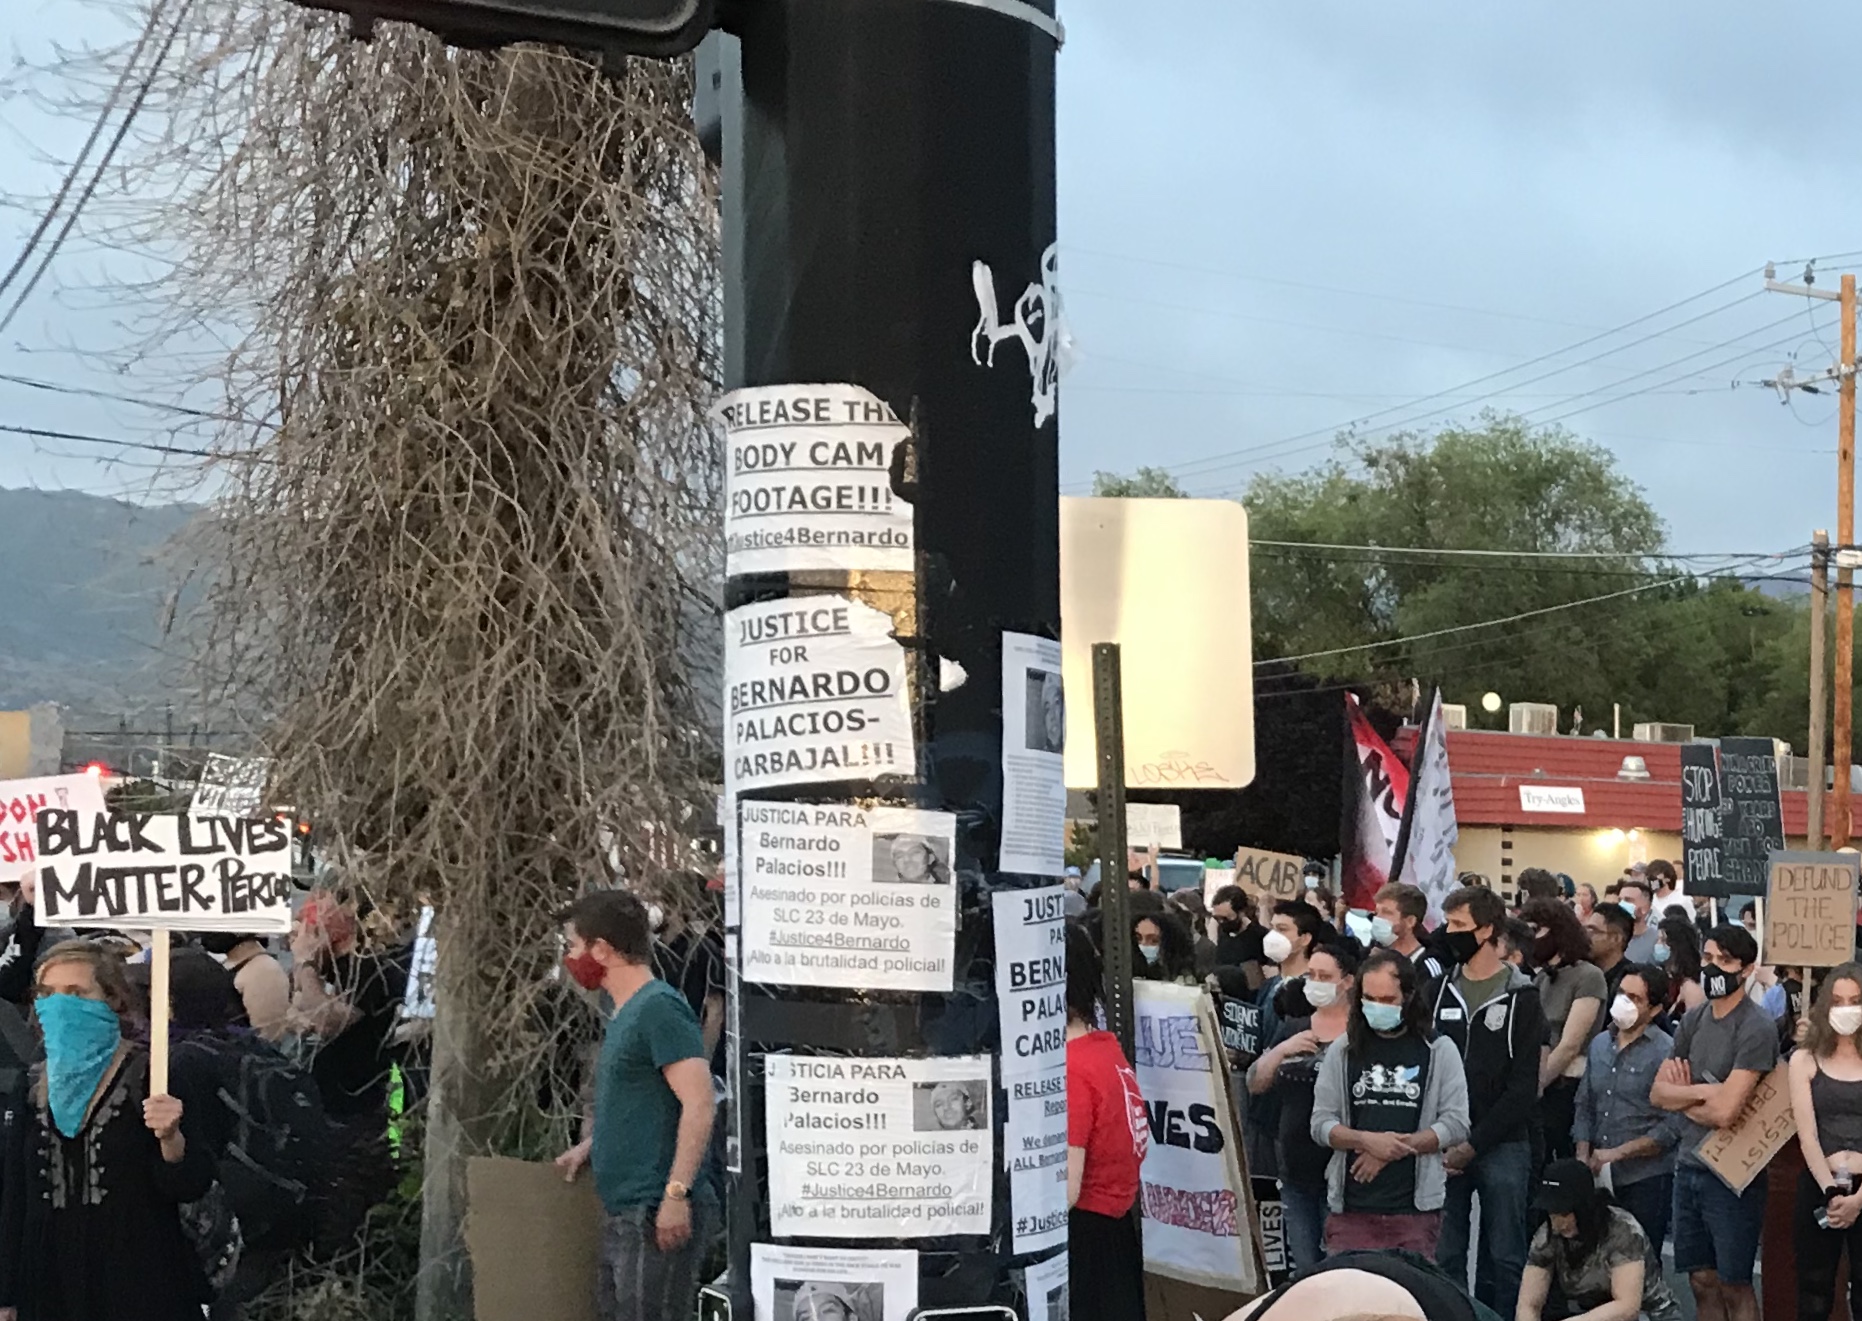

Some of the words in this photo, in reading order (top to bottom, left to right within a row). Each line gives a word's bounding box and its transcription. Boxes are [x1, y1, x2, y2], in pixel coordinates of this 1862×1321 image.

[723, 397, 831, 428] RELEASE
[735, 442, 797, 471] BODY
[809, 441, 884, 467] CAM
[732, 485, 892, 515] FOOTAGE!!!
[740, 607, 850, 643] JUSTICE
[769, 645, 809, 666] FOR
[731, 667, 890, 711] BERNARDO
[737, 707, 881, 744] PALACIOS-
[734, 742, 894, 780] CARBAJAL!!!
[1683, 765, 1713, 803] STOP
[743, 807, 809, 826] JUSTICIA
[815, 811, 869, 828] PARA
[37, 809, 165, 856] BLACK
[178, 814, 288, 856] LIVES
[760, 832, 840, 852] Bernardo
[755, 857, 846, 878] Palacios!!!
[1237, 855, 1299, 896] ACAB
[1778, 866, 1852, 892] DEFUND
[750, 885, 816, 903] Asesinado
[820, 892, 846, 906] por
[920, 894, 941, 909] de
[1786, 896, 1833, 920] THE
[773, 907, 801, 924] SLC
[805, 909, 825, 925] 23
[829, 911, 849, 926] de
[853, 911, 904, 931] Mayo.
[769, 930, 910, 951] #Justice4Bernardo
[1771, 921, 1849, 951] POLICE
[774, 954, 783, 965] a
[785, 950, 797, 965] la
[800, 951, 879, 970] brutalidad
[883, 957, 946, 974] policial!
[1710, 976, 1726, 993] NO
[768, 1063, 845, 1079] JSTICIA
[851, 1064, 906, 1080] PARA
[788, 1086, 879, 1105] Bernardo
[1014, 1076, 1061, 1098] RELEASE
[779, 1140, 855, 1157] Asesinado
[860, 1143, 888, 1159] por
[959, 1139, 979, 1155] de
[806, 1161, 840, 1177] SLC
[844, 1161, 865, 1176] 23
[869, 1161, 891, 1177] de
[896, 1162, 946, 1180] Mayo.
[1014, 1157, 1035, 1170] ALL
[801, 1182, 953, 1199] #Justice4Bernardo
[808, 1207, 819, 1218] a
[840, 1203, 922, 1220] brutalidad
[927, 1202, 985, 1221] policial!
[1262, 1205, 1284, 1266] LIVES
